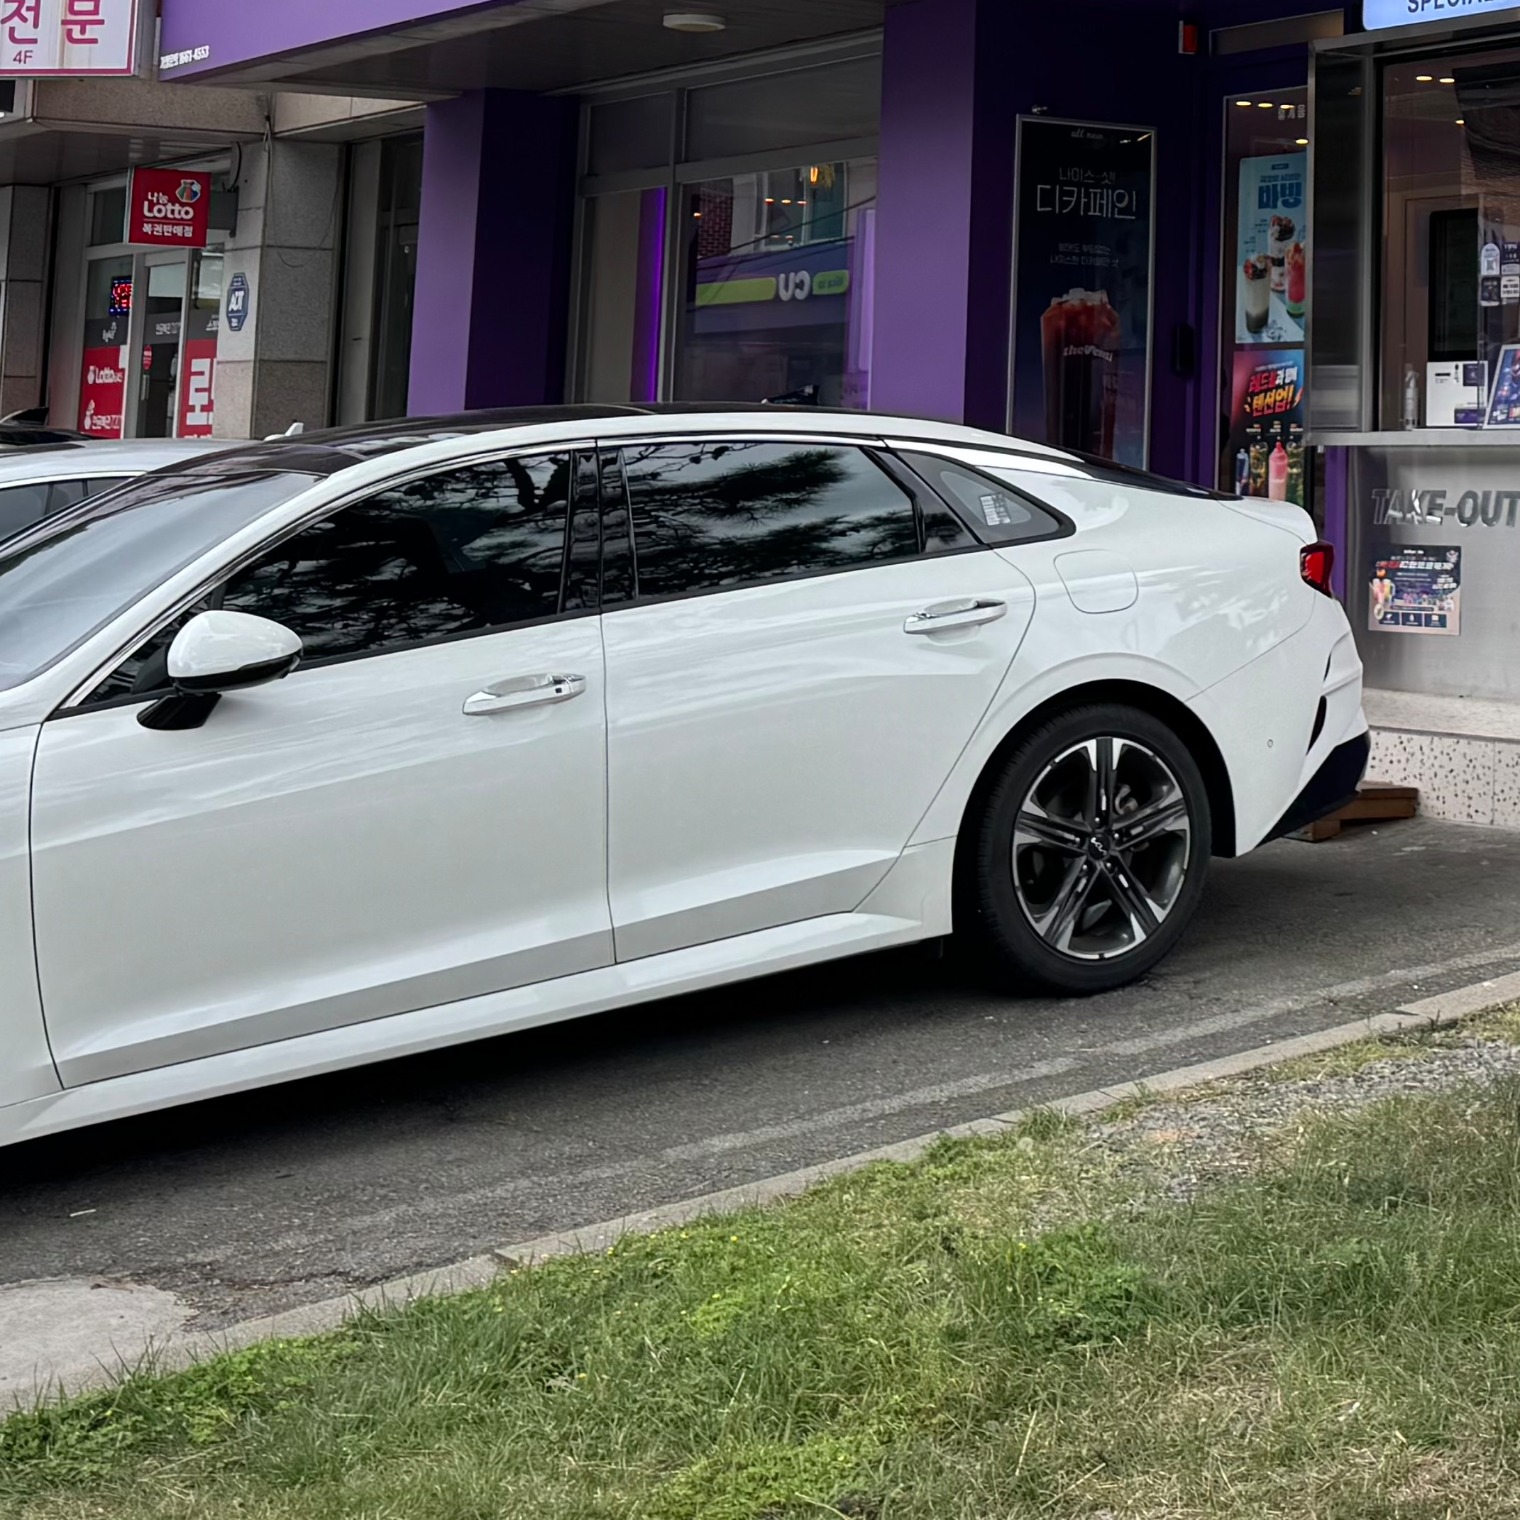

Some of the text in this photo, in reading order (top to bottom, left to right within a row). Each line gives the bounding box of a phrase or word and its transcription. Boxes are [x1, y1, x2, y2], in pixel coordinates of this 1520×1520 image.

[13, 50, 34, 64] 4F
[1036, 184, 1137, 219] 디카페인
[143, 201, 194, 219] Lotto
[142, 223, 193, 238] 복권판매점
